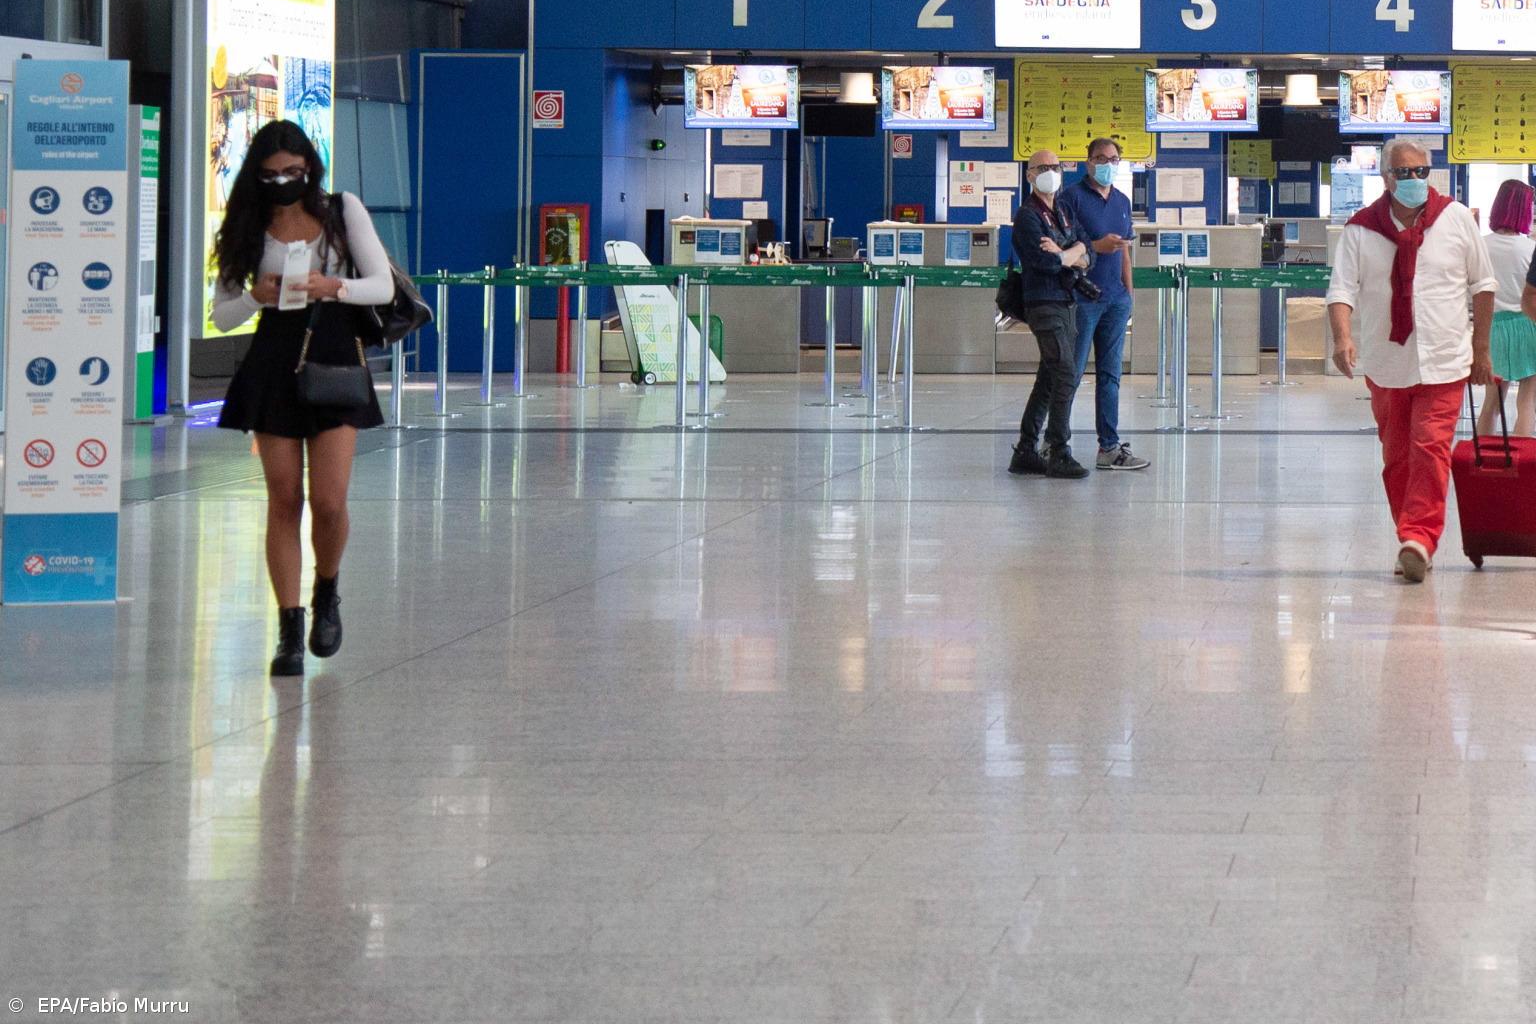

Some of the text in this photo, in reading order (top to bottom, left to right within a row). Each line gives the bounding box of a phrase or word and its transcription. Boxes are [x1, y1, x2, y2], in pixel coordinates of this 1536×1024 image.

[29, 95, 114, 106] Cagliari Airport
[26, 122, 60, 133] REGOLE
[34, 135, 107, 146] DELL'AEROPORTO
[48, 556, 95, 566] COVID-19
